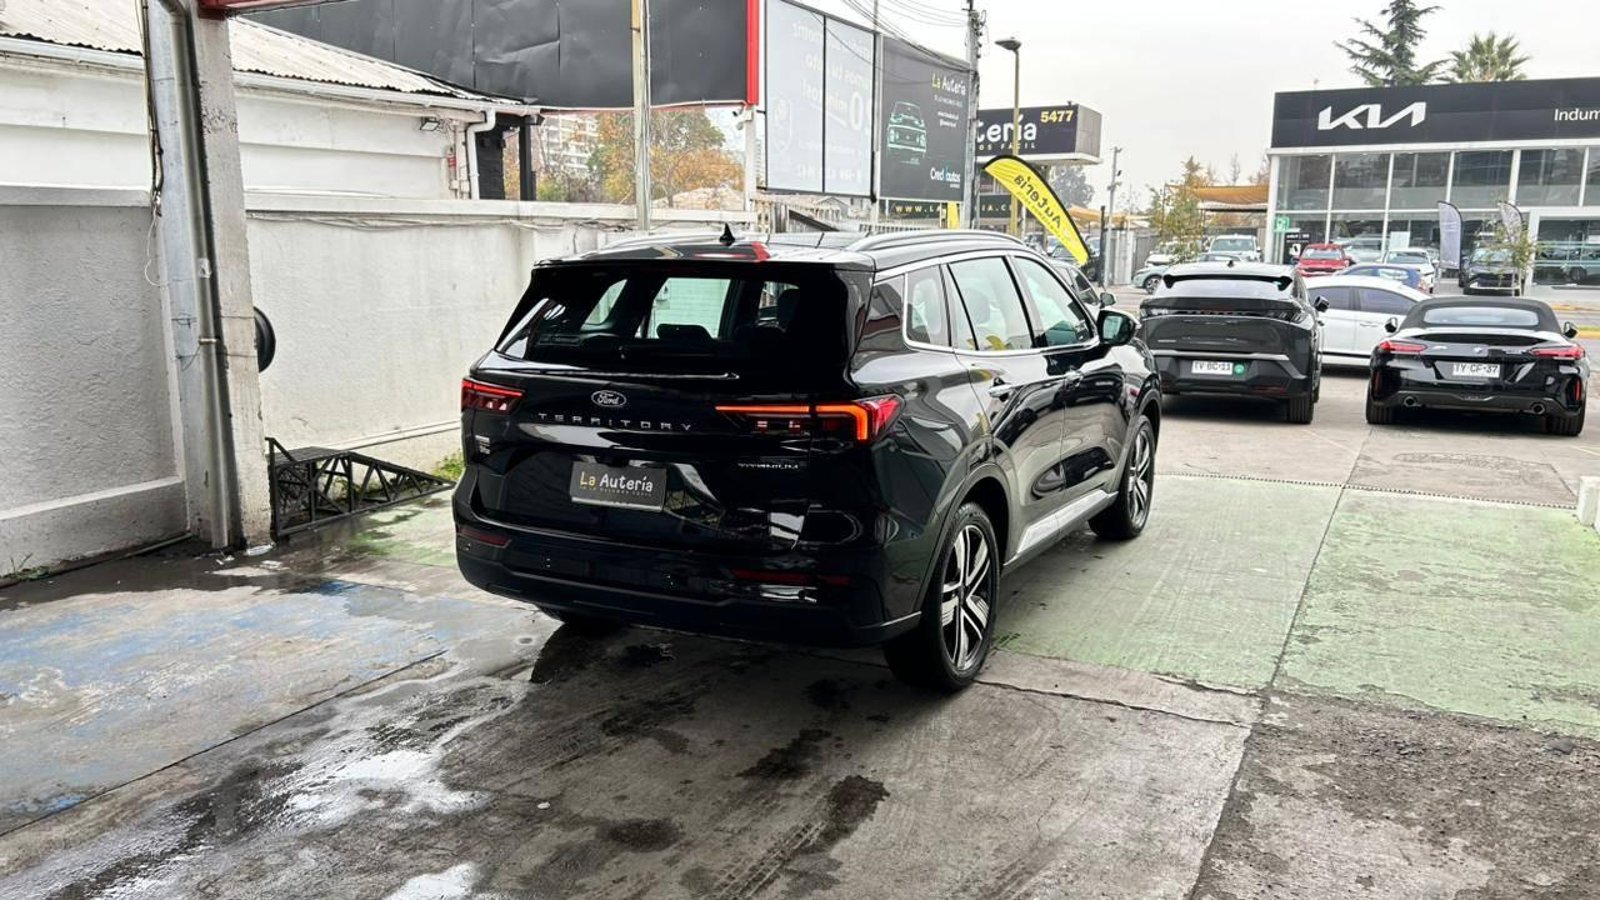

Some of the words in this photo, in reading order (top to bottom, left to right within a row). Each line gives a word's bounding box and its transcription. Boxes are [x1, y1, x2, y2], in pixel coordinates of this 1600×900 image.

[1040, 110, 1073, 123] 5477
[1318, 101, 1427, 131] KIA
[538, 412, 692, 431] TERRITORY
[580, 470, 597, 487] La
[599, 473, 654, 493] Autería
